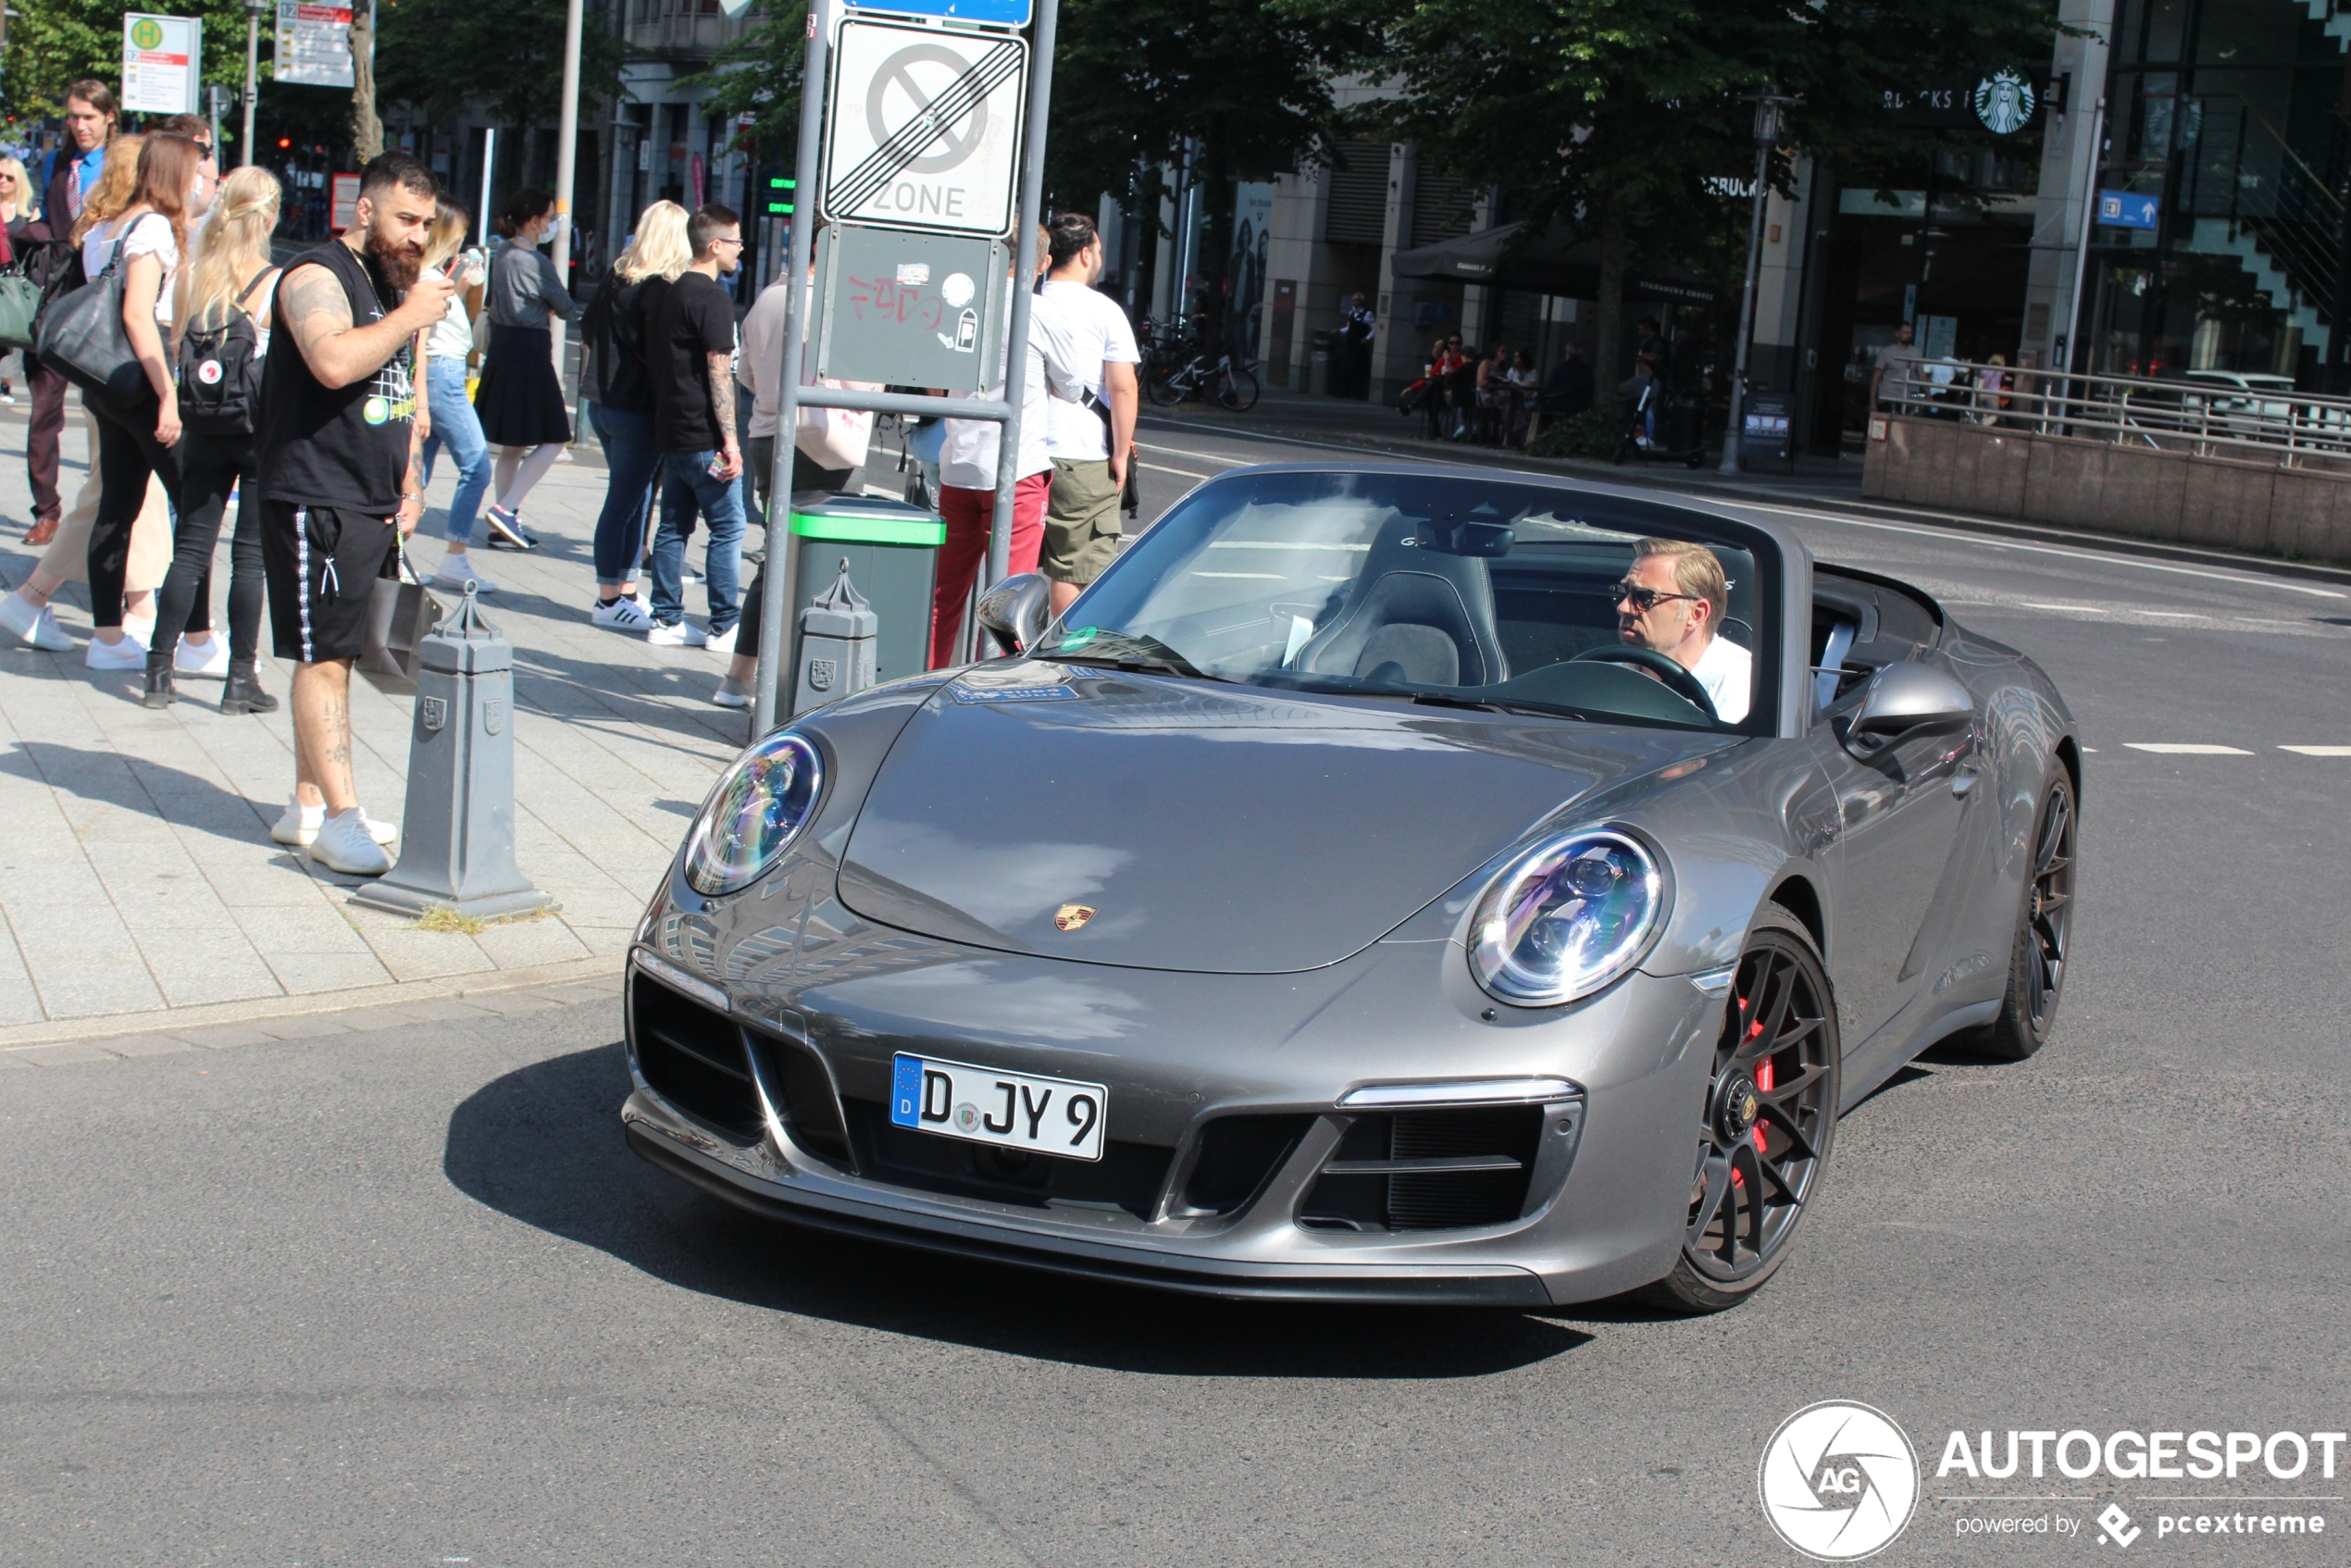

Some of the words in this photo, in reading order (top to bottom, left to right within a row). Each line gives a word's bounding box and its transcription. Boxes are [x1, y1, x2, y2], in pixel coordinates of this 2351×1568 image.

[281, 4, 295, 18] 12
[138, 24, 155, 44] H
[873, 180, 964, 218] ZONE
[901, 1098, 912, 1115] D
[921, 1069, 952, 1123] D
[983, 1080, 1052, 1139] JY
[1067, 1093, 1098, 1146] 9
